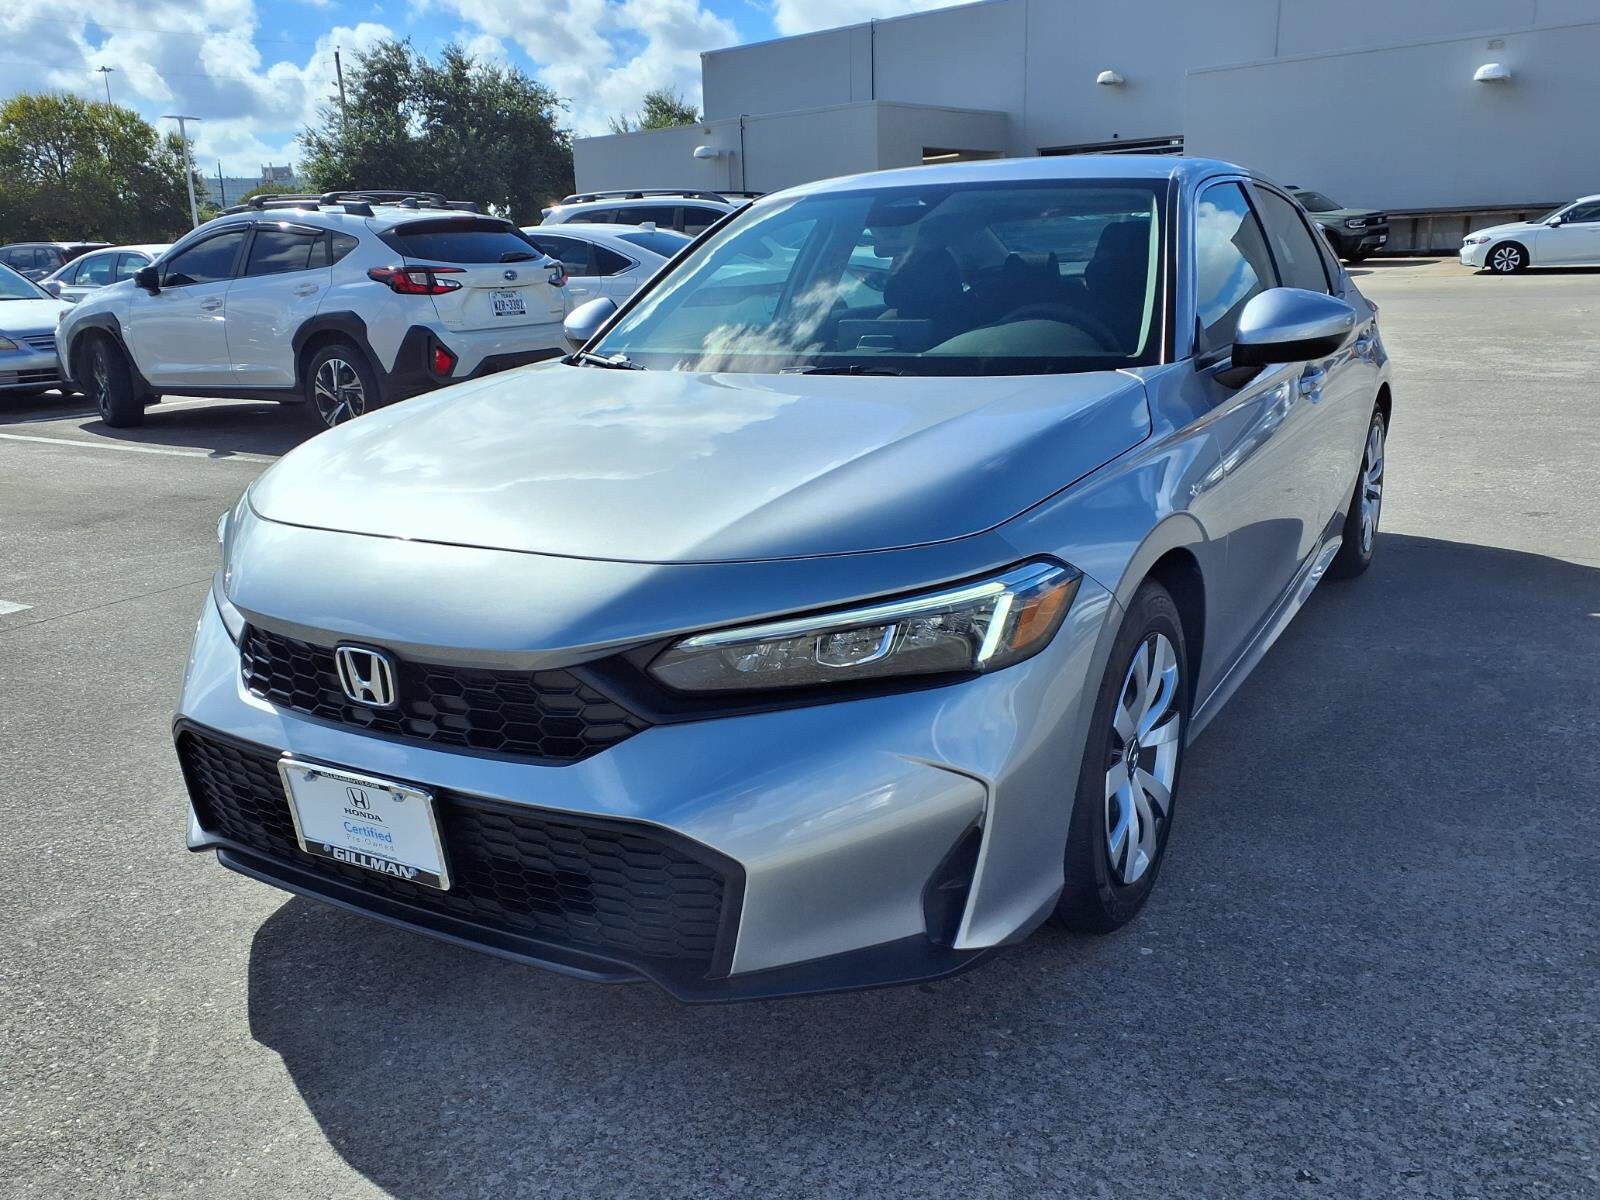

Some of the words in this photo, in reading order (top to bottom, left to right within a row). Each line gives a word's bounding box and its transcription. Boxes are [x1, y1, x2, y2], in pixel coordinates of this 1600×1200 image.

[344, 808, 383, 823] HONDA
[343, 821, 392, 843] Certified
[333, 848, 413, 879] GILLMAN
